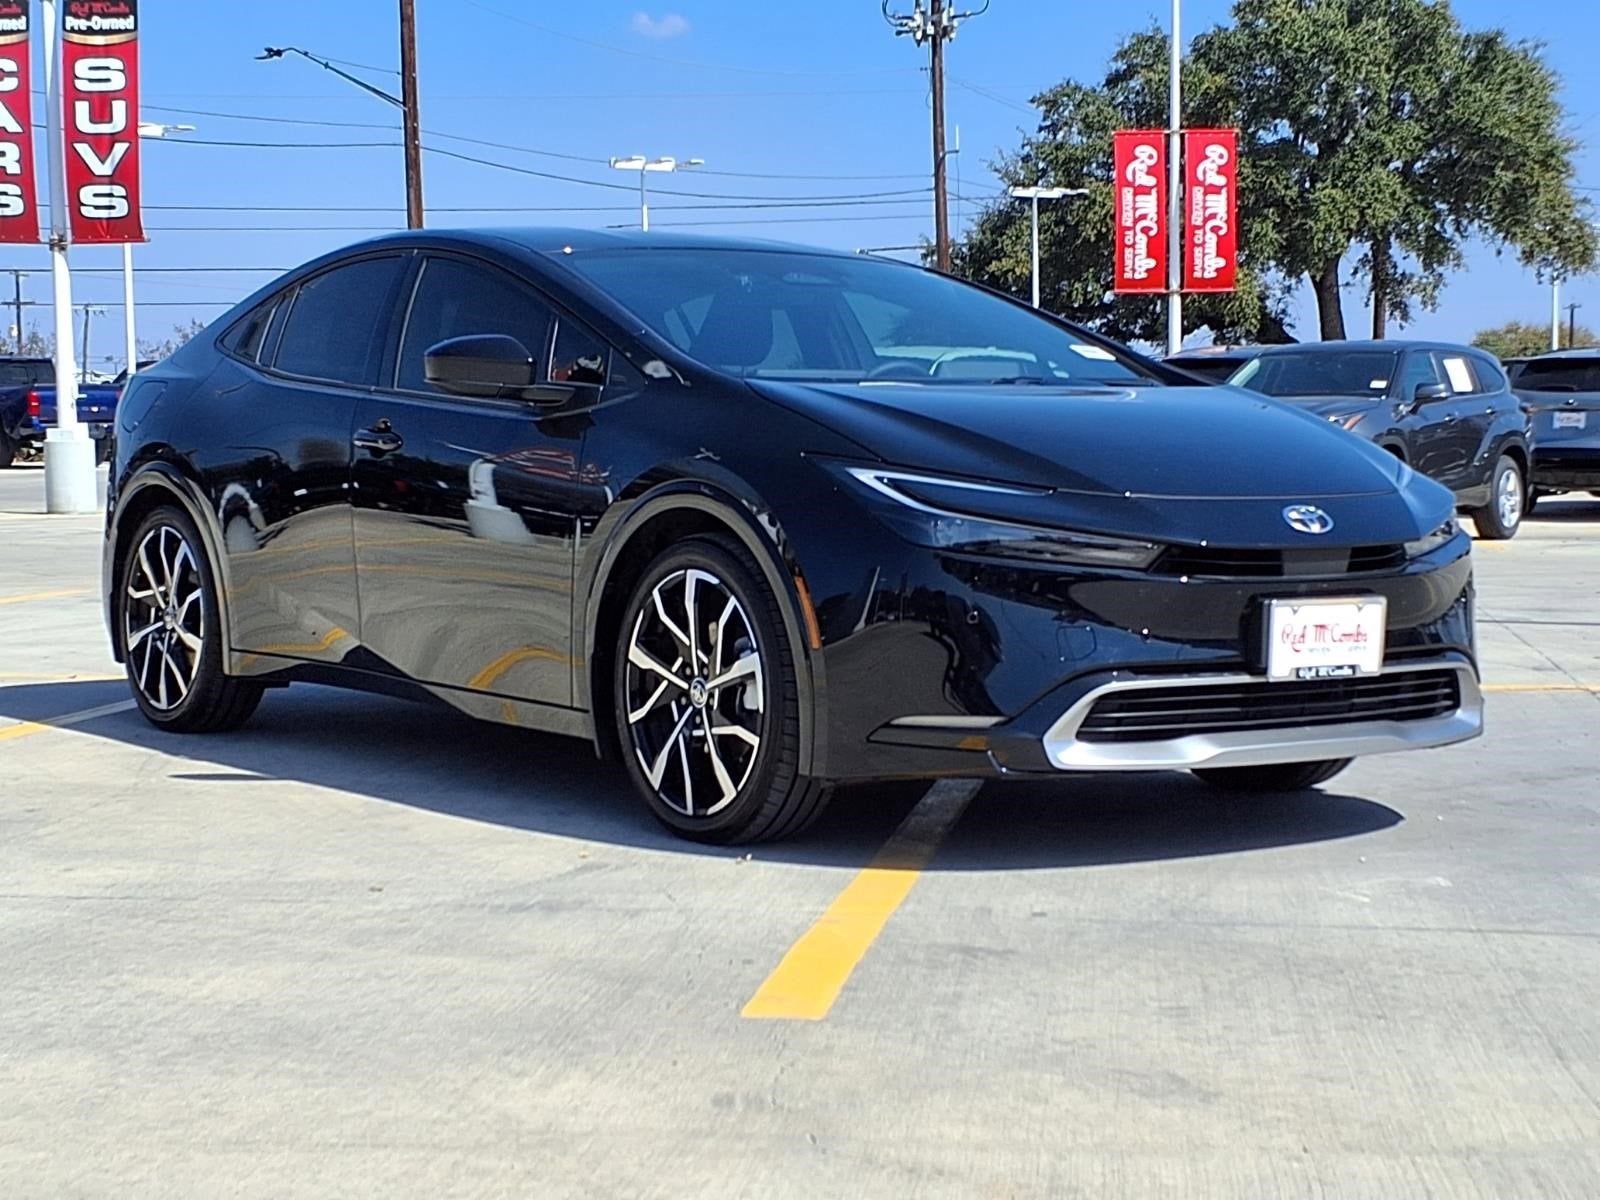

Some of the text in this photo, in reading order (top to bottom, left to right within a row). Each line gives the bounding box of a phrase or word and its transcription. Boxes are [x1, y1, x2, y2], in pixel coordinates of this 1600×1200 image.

[65, 15, 135, 31] Pre-Owned
[73, 57, 130, 219] SUVS
[1126, 144, 1159, 280] Red McCombs
[1196, 144, 1229, 279] Red McCombs
[1124, 230, 1133, 246] TO
[1194, 229, 1204, 245] TO
[1281, 624, 1307, 653] Red
